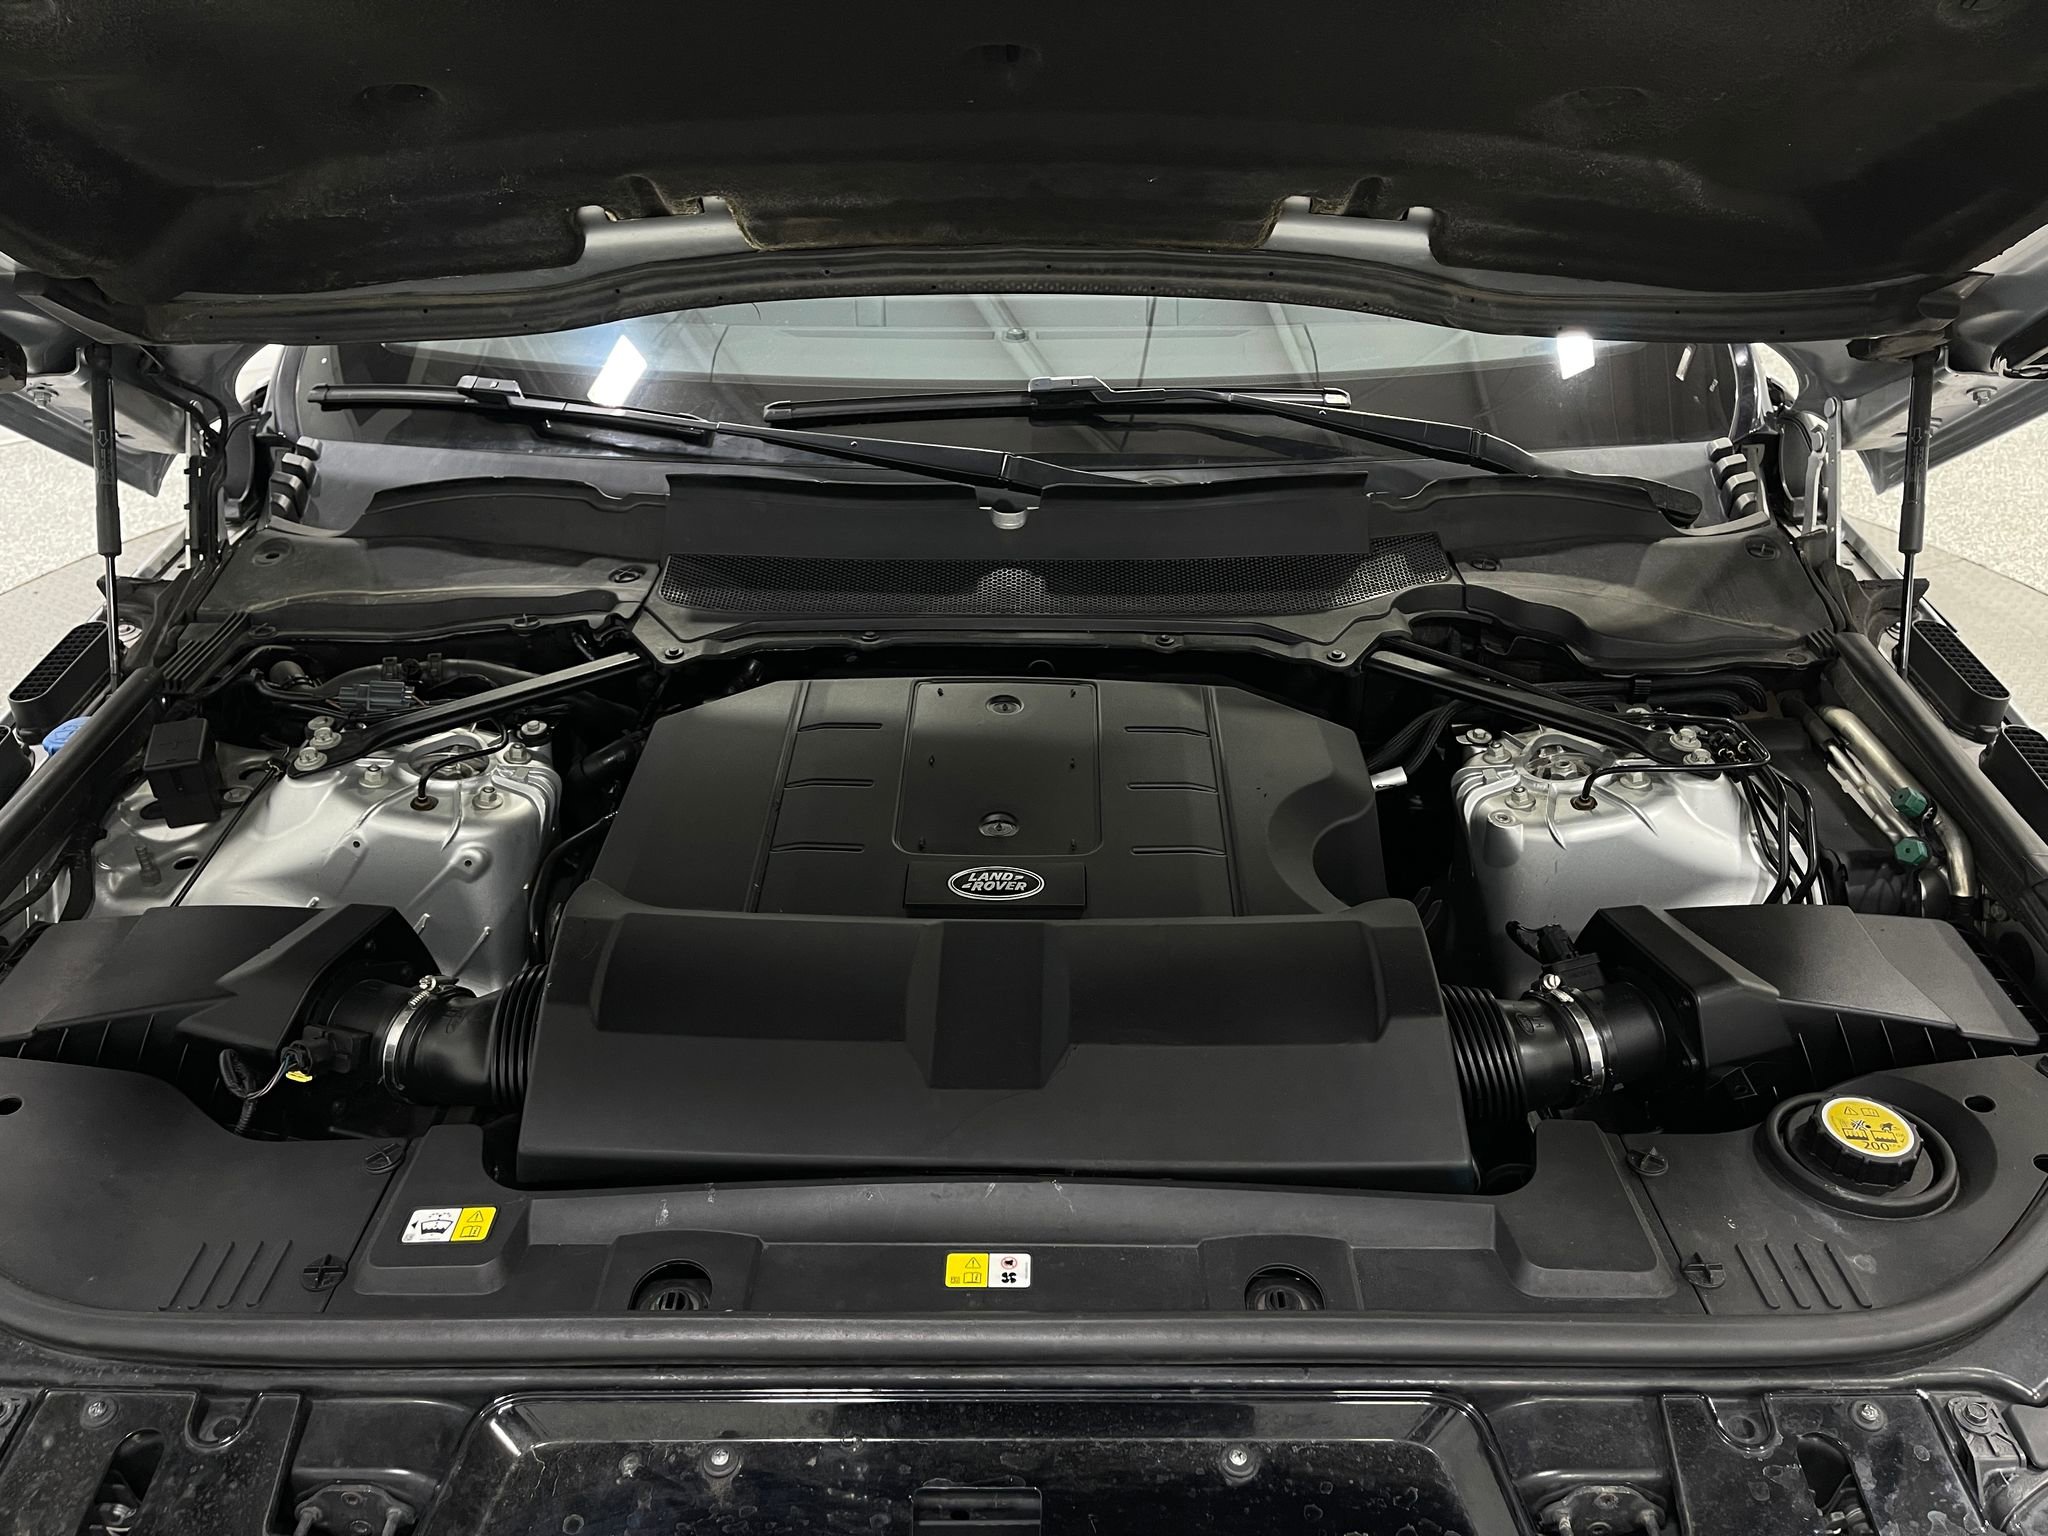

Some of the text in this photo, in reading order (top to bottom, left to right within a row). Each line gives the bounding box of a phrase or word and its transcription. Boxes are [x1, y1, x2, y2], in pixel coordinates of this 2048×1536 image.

[968, 872, 1013, 881] LAND
[971, 881, 1027, 891] ROVER
[1864, 1142, 1889, 1151] 200
